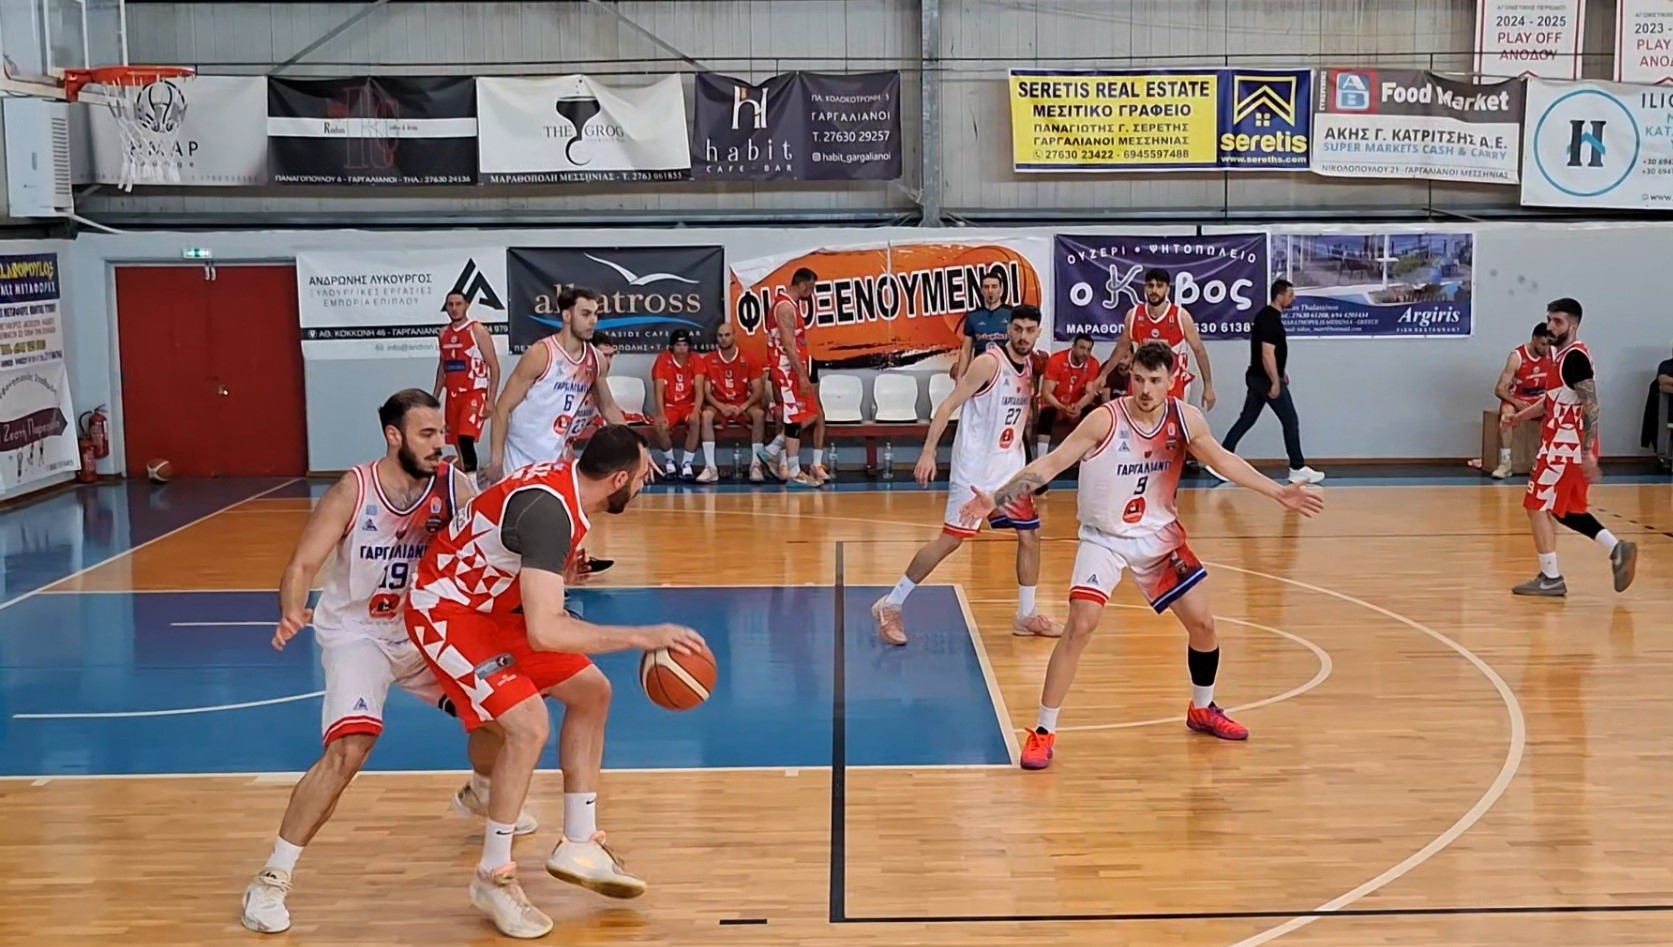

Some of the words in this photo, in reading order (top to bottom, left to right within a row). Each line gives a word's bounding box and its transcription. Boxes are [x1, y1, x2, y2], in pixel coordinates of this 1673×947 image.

[1496, 16, 1525, 27] 2024
[1537, 16, 1566, 27] 2025
[1635, 23, 1664, 34] 2023
[1498, 32, 1531, 44] PLAY
[1536, 32, 1562, 44] OFF
[1637, 39, 1671, 50] PLAY
[1500, 49, 1557, 61] ΑΝΟΔΟΥ
[1018, 81, 1090, 99] SERETIS
[1096, 82, 1139, 98] REAL
[1146, 81, 1210, 98] ESTATE
[1381, 82, 1432, 104] Food
[1436, 85, 1510, 112] Market
[811, 111, 890, 122] ΓΑΡΓΑΛΙΑΝΟΙ
[1033, 104, 1113, 118] ΜΕΣΙΤΙΚΟ
[1119, 104, 1191, 117] ΓΡΑΦΕΙΟ
[543, 125, 573, 138] THE
[584, 125, 624, 138] GROG
[1034, 123, 1114, 133] ΠΑΝΑΓΙΩΤΗΣ
[1119, 123, 1129, 133] Γ.
[1133, 123, 1189, 132] ΣΕΡΕΤΗΣ
[1645, 126, 1673, 136] ΚΑΤ
[823, 131, 856, 142] 27630
[858, 130, 890, 142] 29257
[1034, 137, 1115, 146] ΓΑΡΓΑΛΙΑΝΟΙ
[1118, 136, 1189, 146] ΜΕΣΣΗΝΙΑΣ
[1220, 131, 1308, 153] seretis
[1324, 127, 1370, 141] ΑΚΗΣ
[1375, 128, 1386, 141] Γ.
[1392, 129, 1476, 146] ΚΑΤΡΙΤΣΗΣ
[1480, 136, 1507, 149] Α.Ε.
[706, 138, 793, 162] habit
[1045, 150, 1078, 159] 27630
[1081, 150, 1114, 159] 23422
[1124, 150, 1189, 159] 6945597488
[1323, 142, 1361, 152] SUPER
[1365, 142, 1419, 153] MARKETS
[1422, 145, 1454, 155] CASH
[1457, 147, 1466, 156] &
[1470, 148, 1507, 160] CARRY
[822, 152, 891, 164] habit_gargalianoi
[706, 165, 744, 173] CAFE
[764, 164, 792, 172] BAR
[1321, 164, 1389, 173] ΝΙΚΟΛΟΠΟΥΛΟΥ
[1405, 166, 1459, 176] ΓΑΡΓΑΛΙΑΝΟΙ
[1460, 169, 1509, 179] ΜΕΣΣΗΝΙΑΣ
[490, 174, 557, 184] ΜΑΡΑΘΟΠΟΛΗ
[560, 172, 615, 182] ΜΕΣΣΗΝΙΑΣ
[633, 172, 651, 181] 2763
[1067, 246, 1126, 265] ΟΥΖΕΡΙ
[1149, 244, 1256, 264] ΨΗΤΟΠΩΛΕΙΟ
[309, 276, 367, 286] ΑΝΔΡΩΝΗΣ
[370, 273, 433, 284] ΛΥΚΟΥΡΓΟΣ
[383, 286, 432, 296] ΕΡΓΑΣΙΕΣ
[1102, 264, 1254, 311] Κβος
[323, 298, 370, 307] ΕΜΠΟΡΙΑ
[374, 297, 419, 307] ΕΠΙΠΛΟΥ
[534, 283, 701, 315] alatross
[737, 261, 1022, 335] ΦΙΟΞΕΝΟΥΜΕΝΟΙ
[1397, 306, 1460, 327] Argiris
[392, 327, 440, 336] ΓΑΡΓΑΛΙΑΝΟ
[1221, 322, 1255, 333] 6138
[563, 394, 575, 412] 6
[1005, 408, 1021, 425] 27
[1134, 476, 1148, 495] 9
[360, 544, 429, 560] ΓΑΡΓΑΛΙΑΝ
[378, 562, 409, 590] 19
